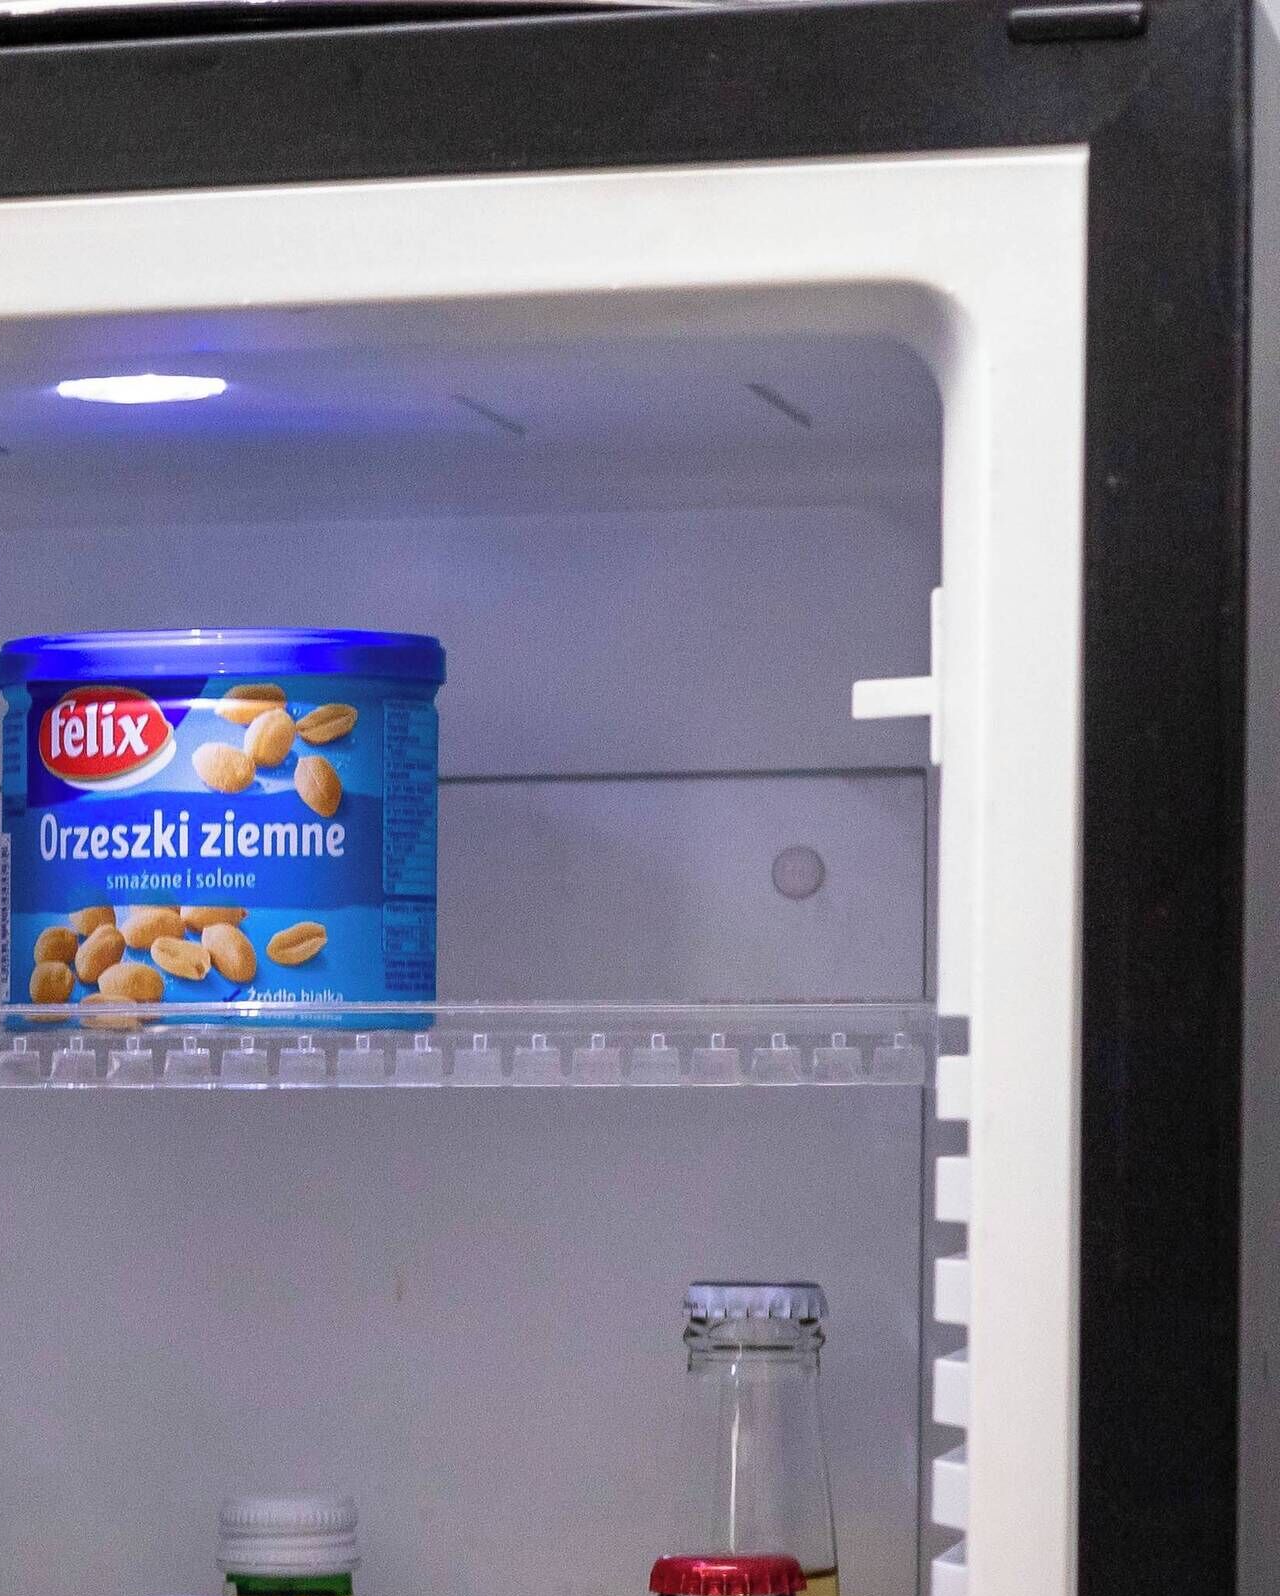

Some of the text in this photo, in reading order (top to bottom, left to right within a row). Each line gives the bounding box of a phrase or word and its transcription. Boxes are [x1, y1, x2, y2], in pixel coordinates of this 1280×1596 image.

[40, 808, 346, 862] Orzeszki ziemne
[106, 867, 257, 890] smażone i solone
